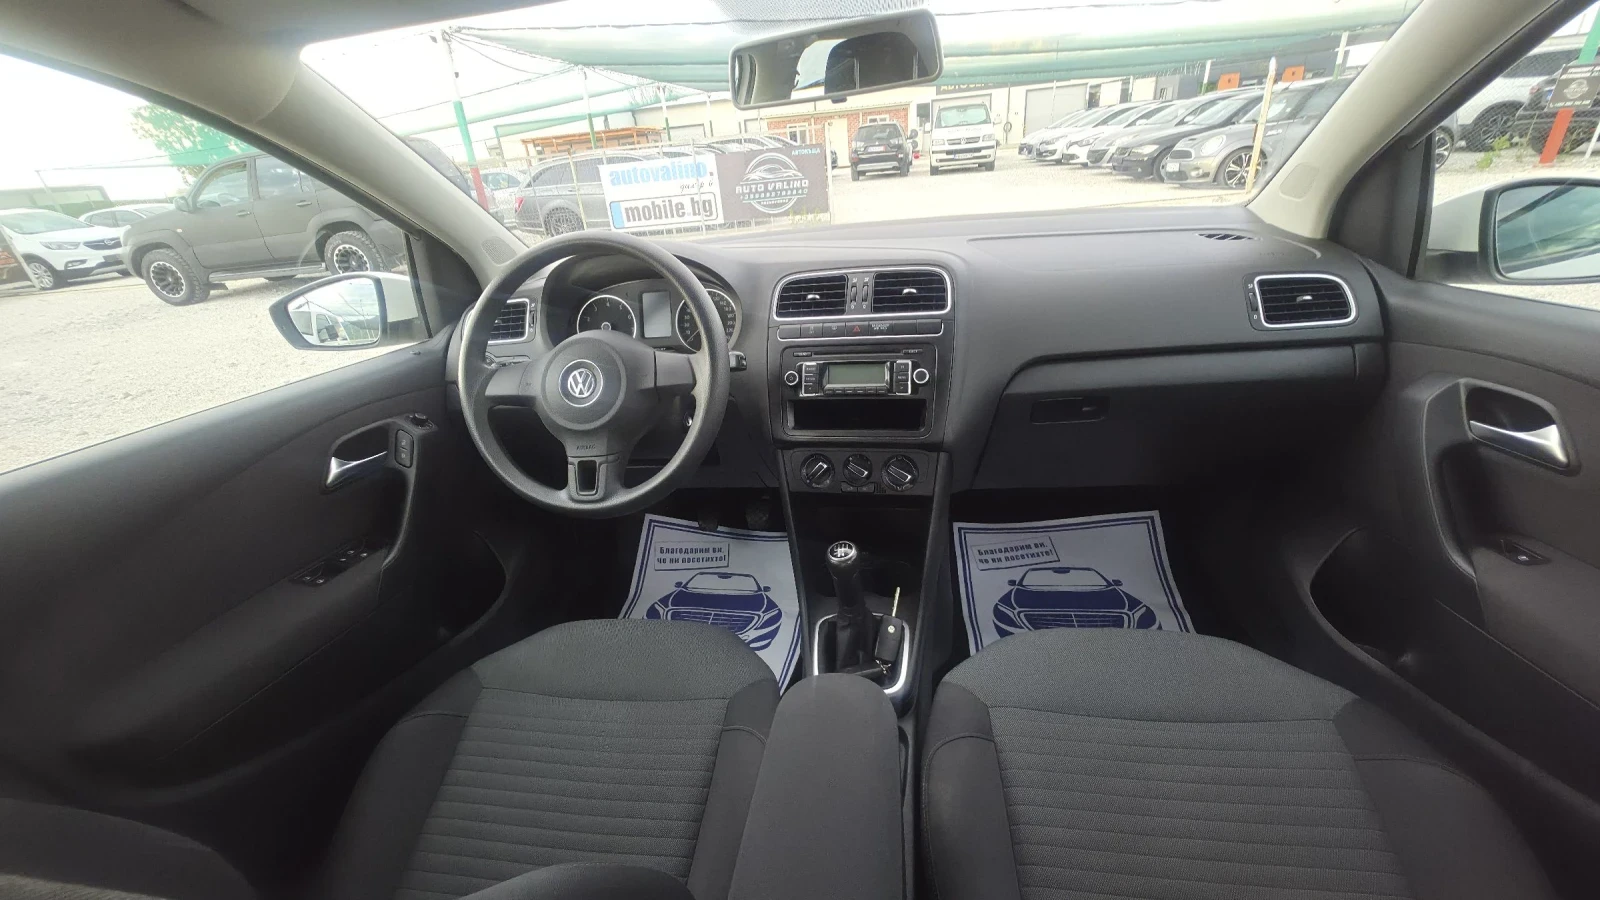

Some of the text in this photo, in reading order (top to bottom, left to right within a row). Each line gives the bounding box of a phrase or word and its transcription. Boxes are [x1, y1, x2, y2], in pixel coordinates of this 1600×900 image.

[735, 179, 809, 194] AUTO VALINO
[624, 197, 713, 223] mobile.bg
[659, 546, 711, 556] Благодарим
[977, 543, 1033, 556] Благодарим
[1004, 549, 1054, 562] посетихте!
[681, 554, 726, 564] посетихте!
